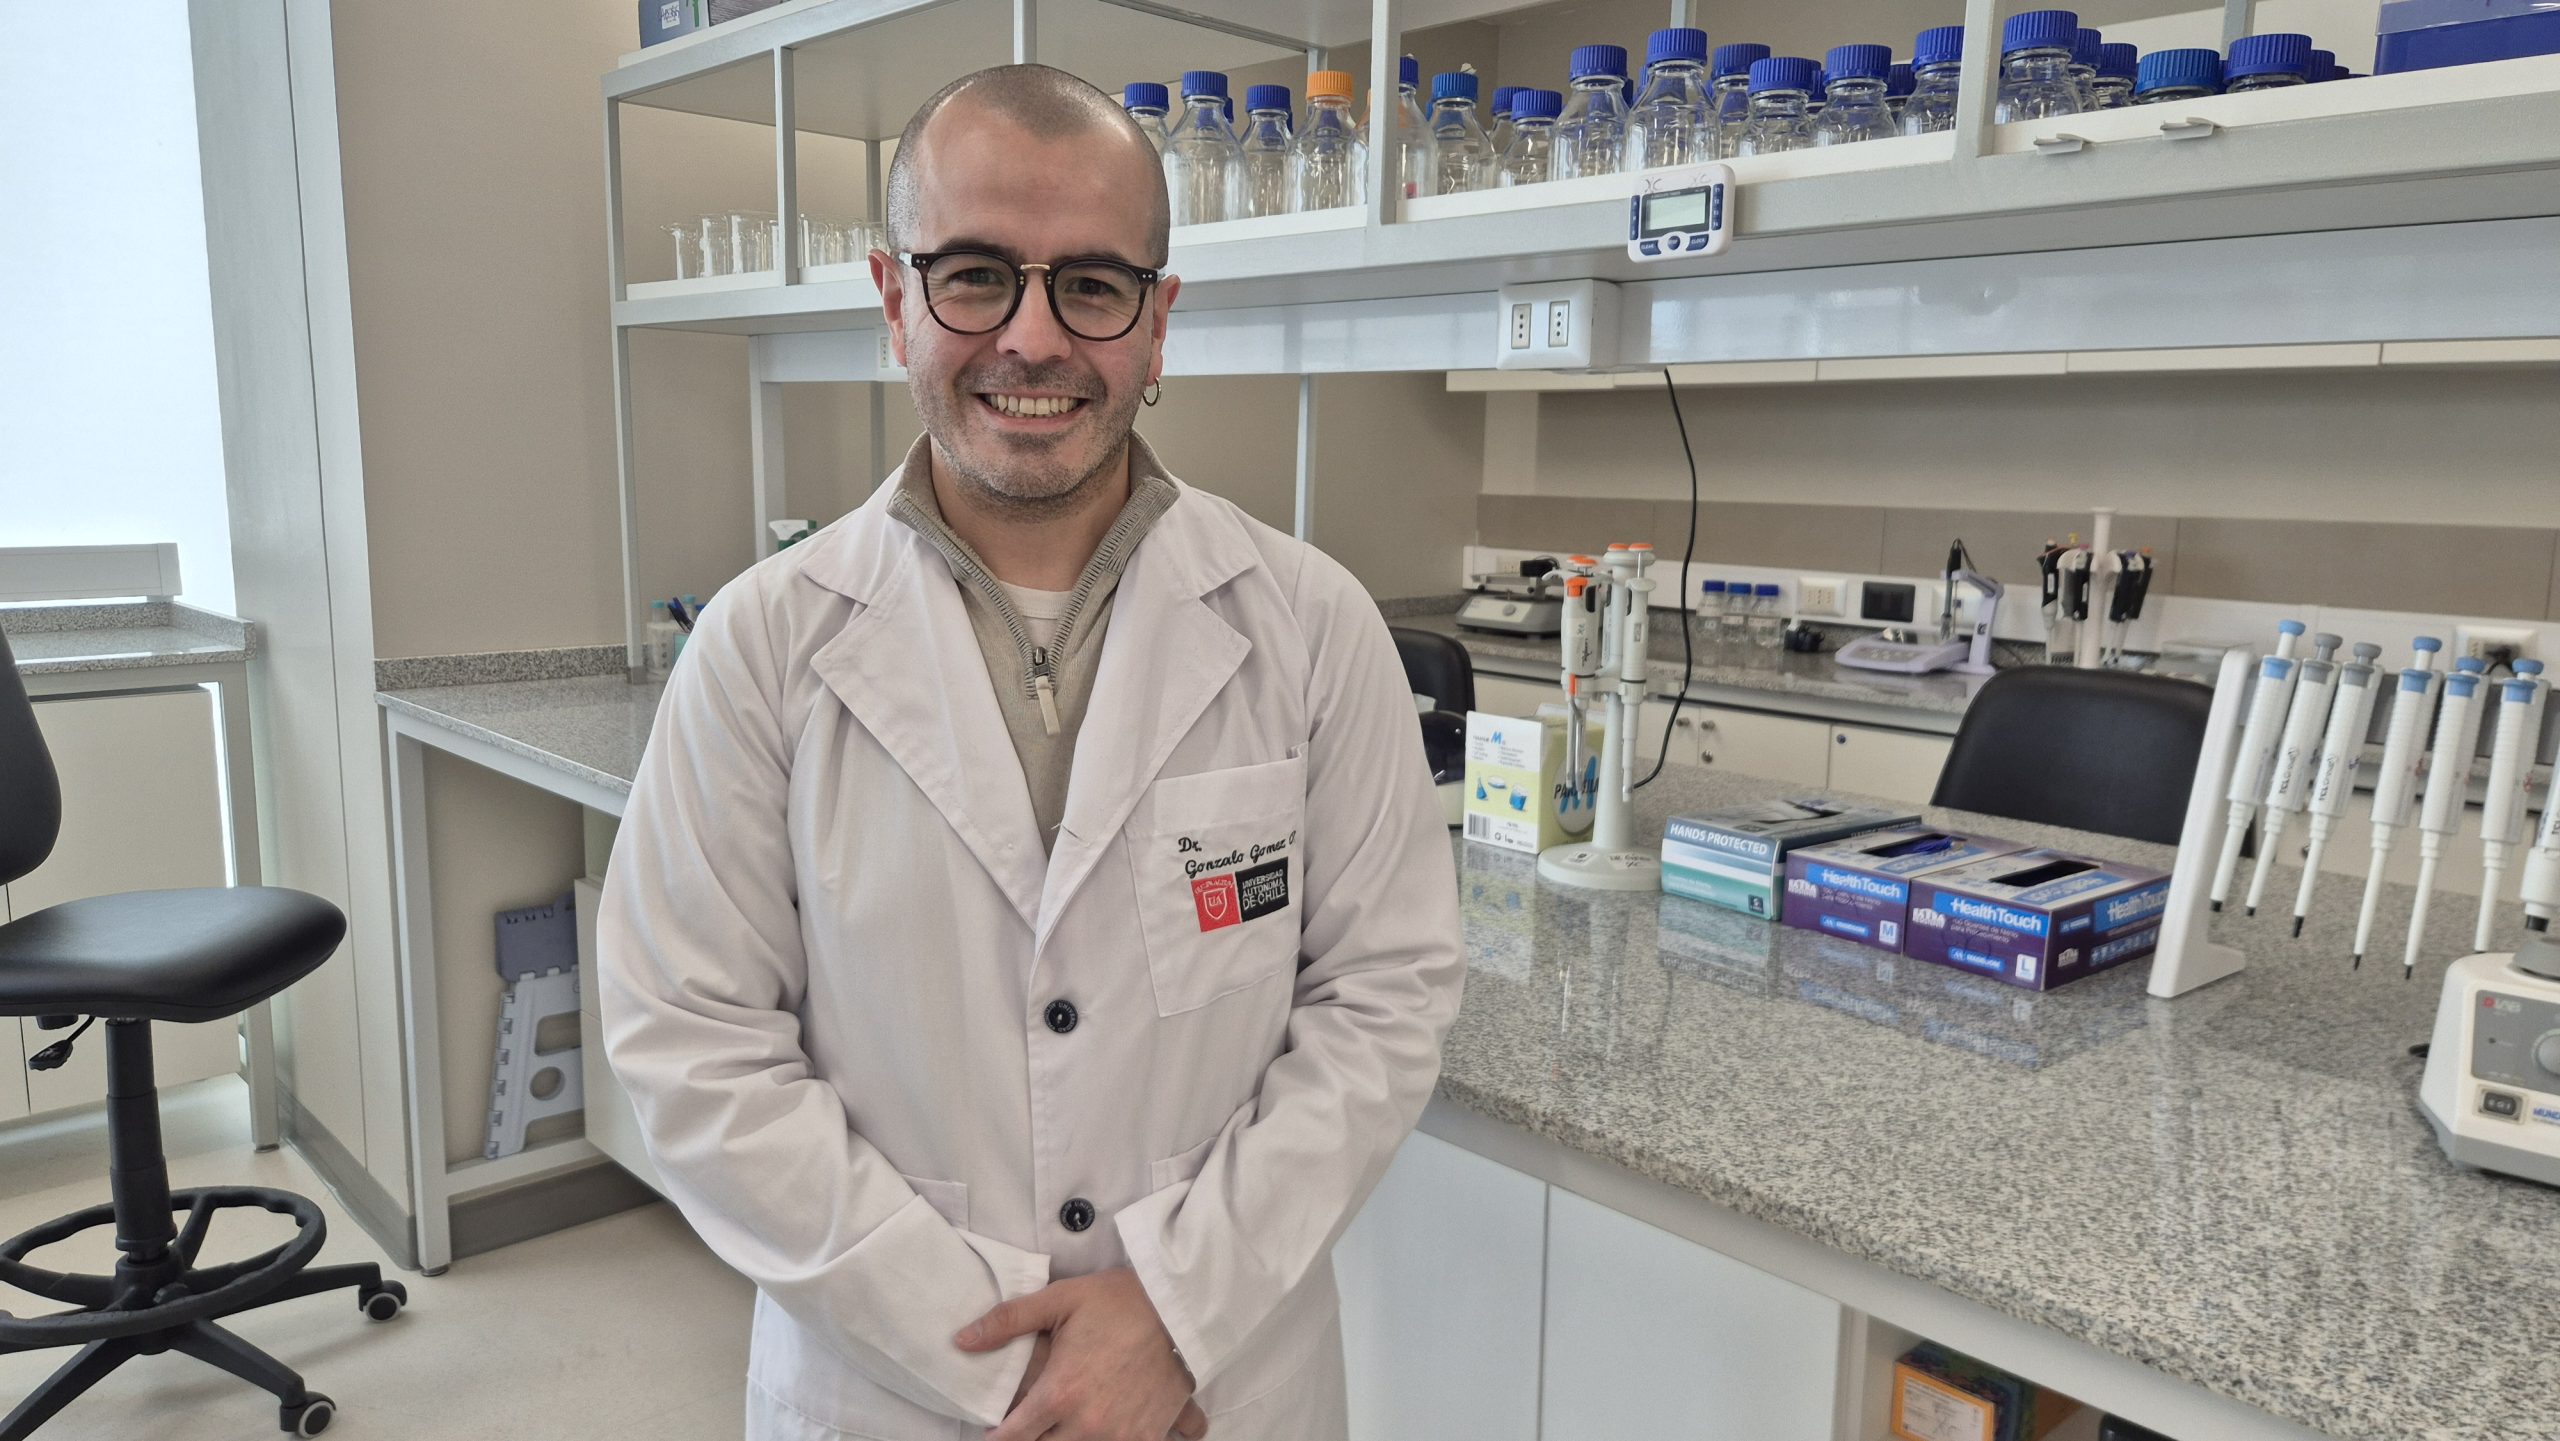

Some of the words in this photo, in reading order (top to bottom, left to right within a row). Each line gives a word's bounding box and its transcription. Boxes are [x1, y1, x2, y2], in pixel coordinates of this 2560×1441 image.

[1178, 837, 1202, 852] Dr.
[1670, 823, 1706, 842] HANDS
[1707, 832, 1768, 855] PROTECTED
[1185, 850, 1244, 878] Gonzalo
[1250, 838, 1286, 863] Gomez
[1242, 869, 1283, 889] UNIVERSIDAD
[1821, 868, 1900, 898] HealthTouch
[1243, 897, 1256, 911] DE
[1257, 886, 1287, 905] CHILE
[1950, 897, 2042, 931] HealthTouch
[1882, 923, 1894, 937] M
[2022, 957, 2031, 972] L
